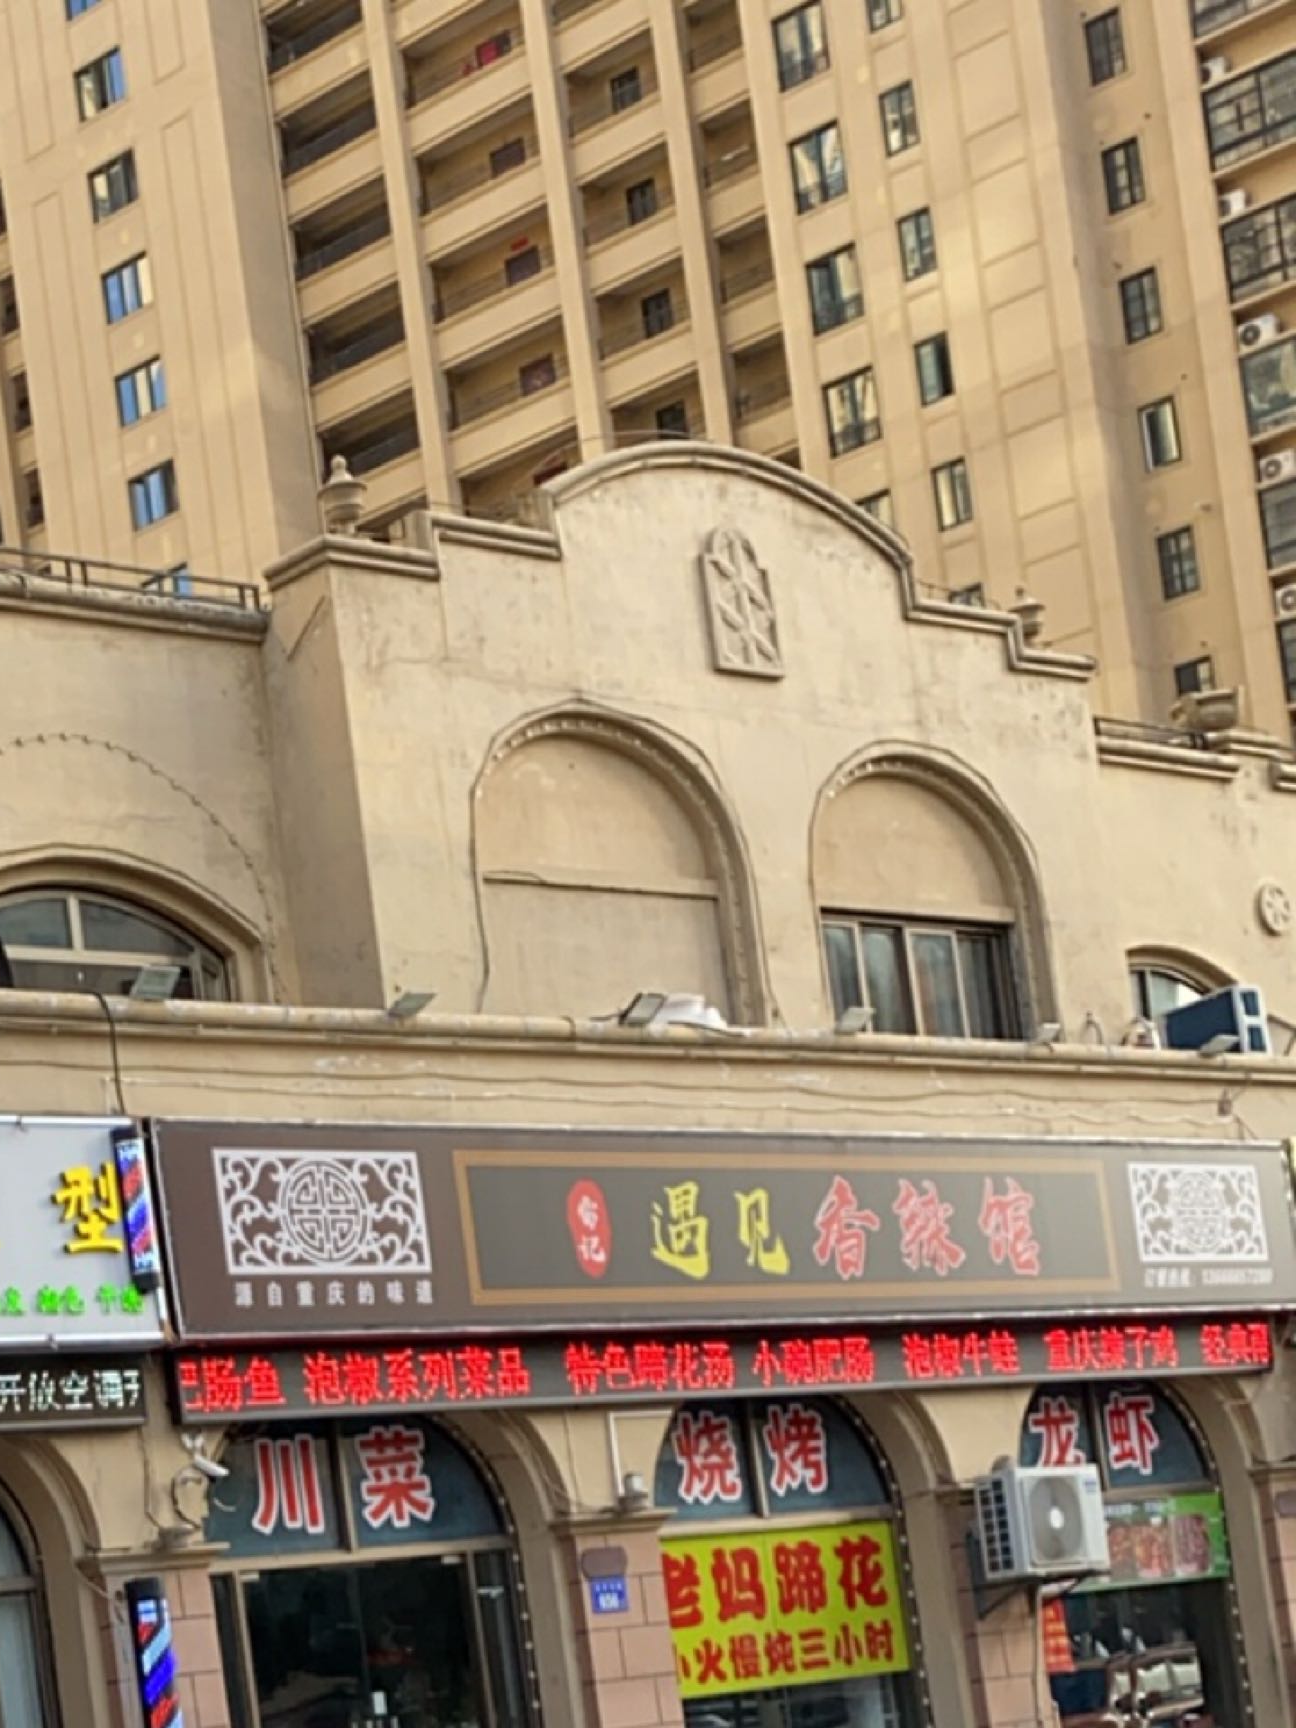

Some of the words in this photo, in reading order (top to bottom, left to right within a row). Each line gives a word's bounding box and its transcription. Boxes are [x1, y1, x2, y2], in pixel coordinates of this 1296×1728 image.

[651, 1174, 1041, 1281] 遇见香辣馆
[303, 1346, 530, 1404] 泡椒系列菜品
[252, 1425, 434, 1535] 川菜
[672, 1403, 828, 1505] 烧烤
[1027, 1391, 1161, 1475] 龙虾
